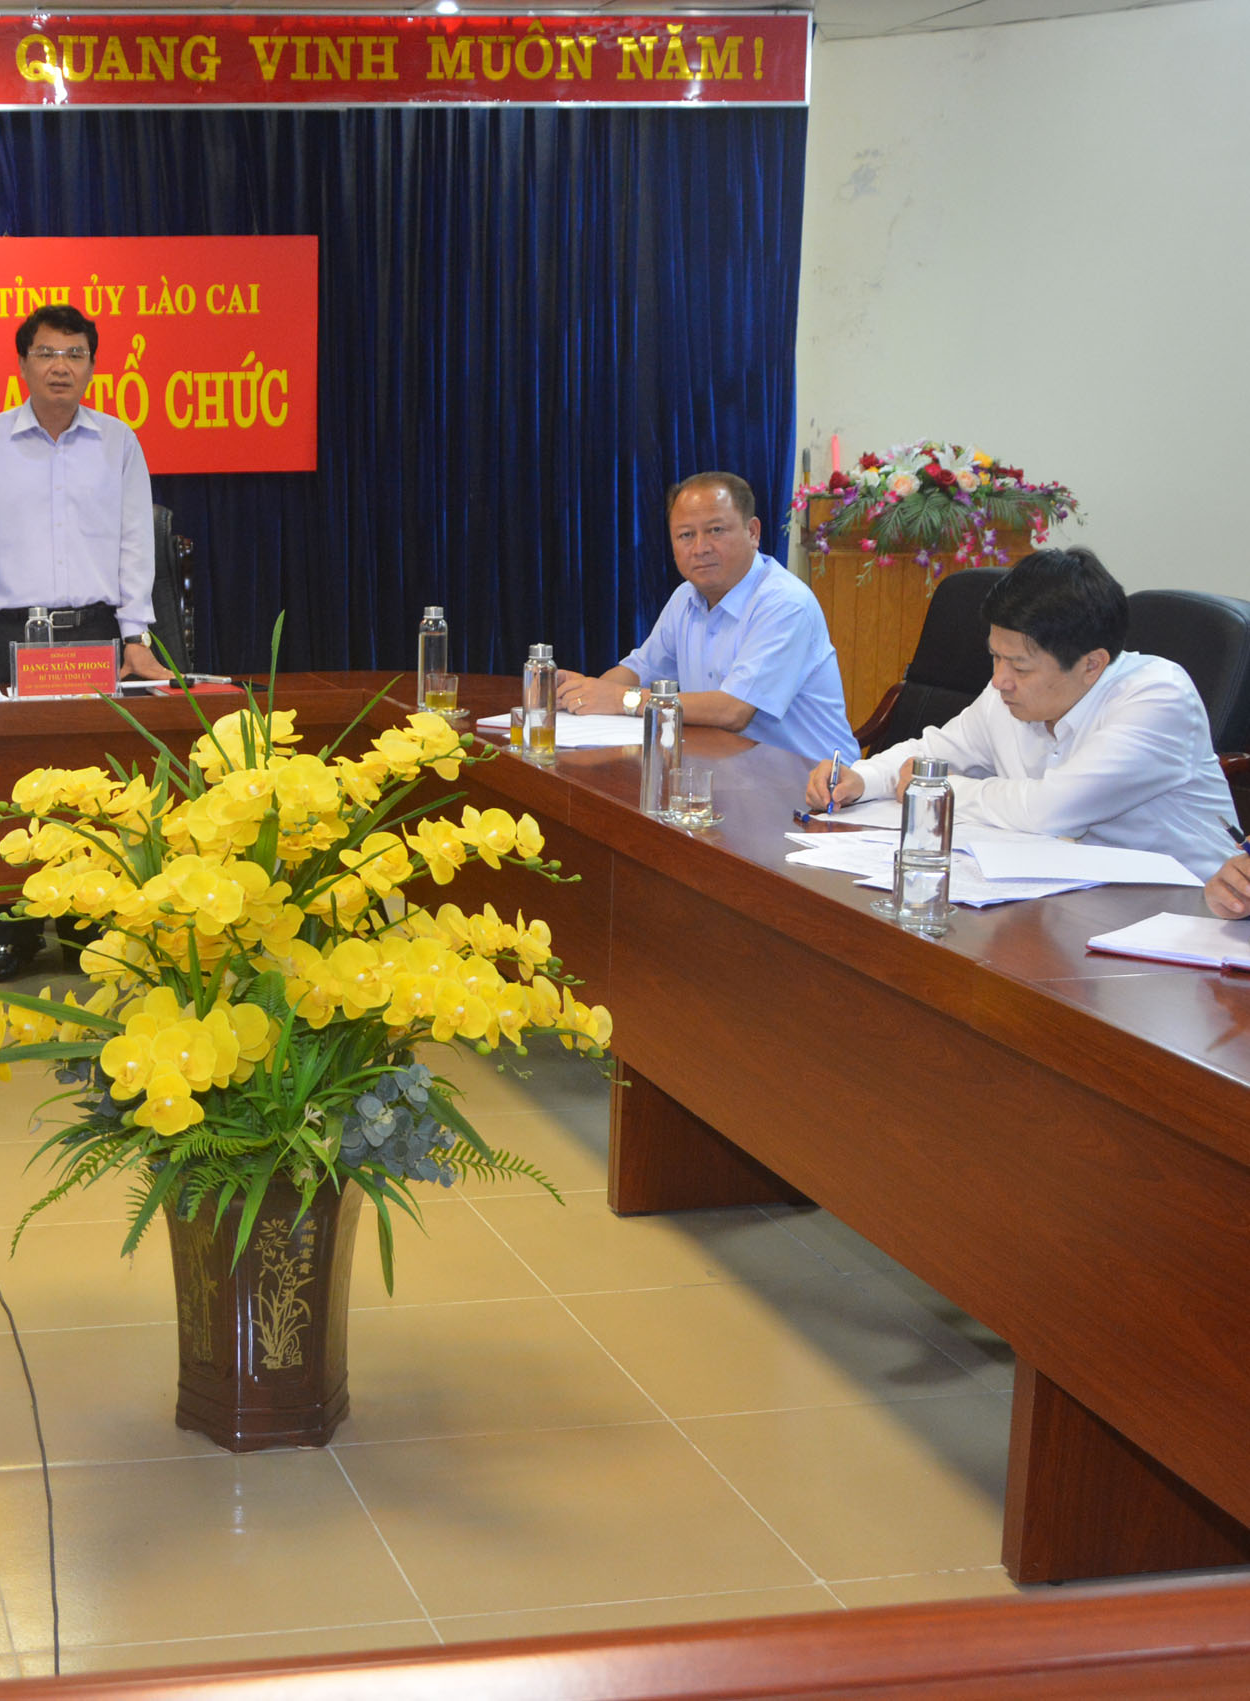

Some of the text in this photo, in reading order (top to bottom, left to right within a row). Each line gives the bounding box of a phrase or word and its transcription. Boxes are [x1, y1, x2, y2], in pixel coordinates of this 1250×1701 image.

[15, 33, 222, 84] QUANG
[248, 35, 399, 82] VINH
[426, 19, 597, 81] MUÔN
[83, 273, 125, 317] ỦY
[137, 275, 196, 315] LÀO
[206, 283, 260, 314] CAI
[85, 333, 150, 430] TỔ
[165, 351, 289, 429] CHỨC
